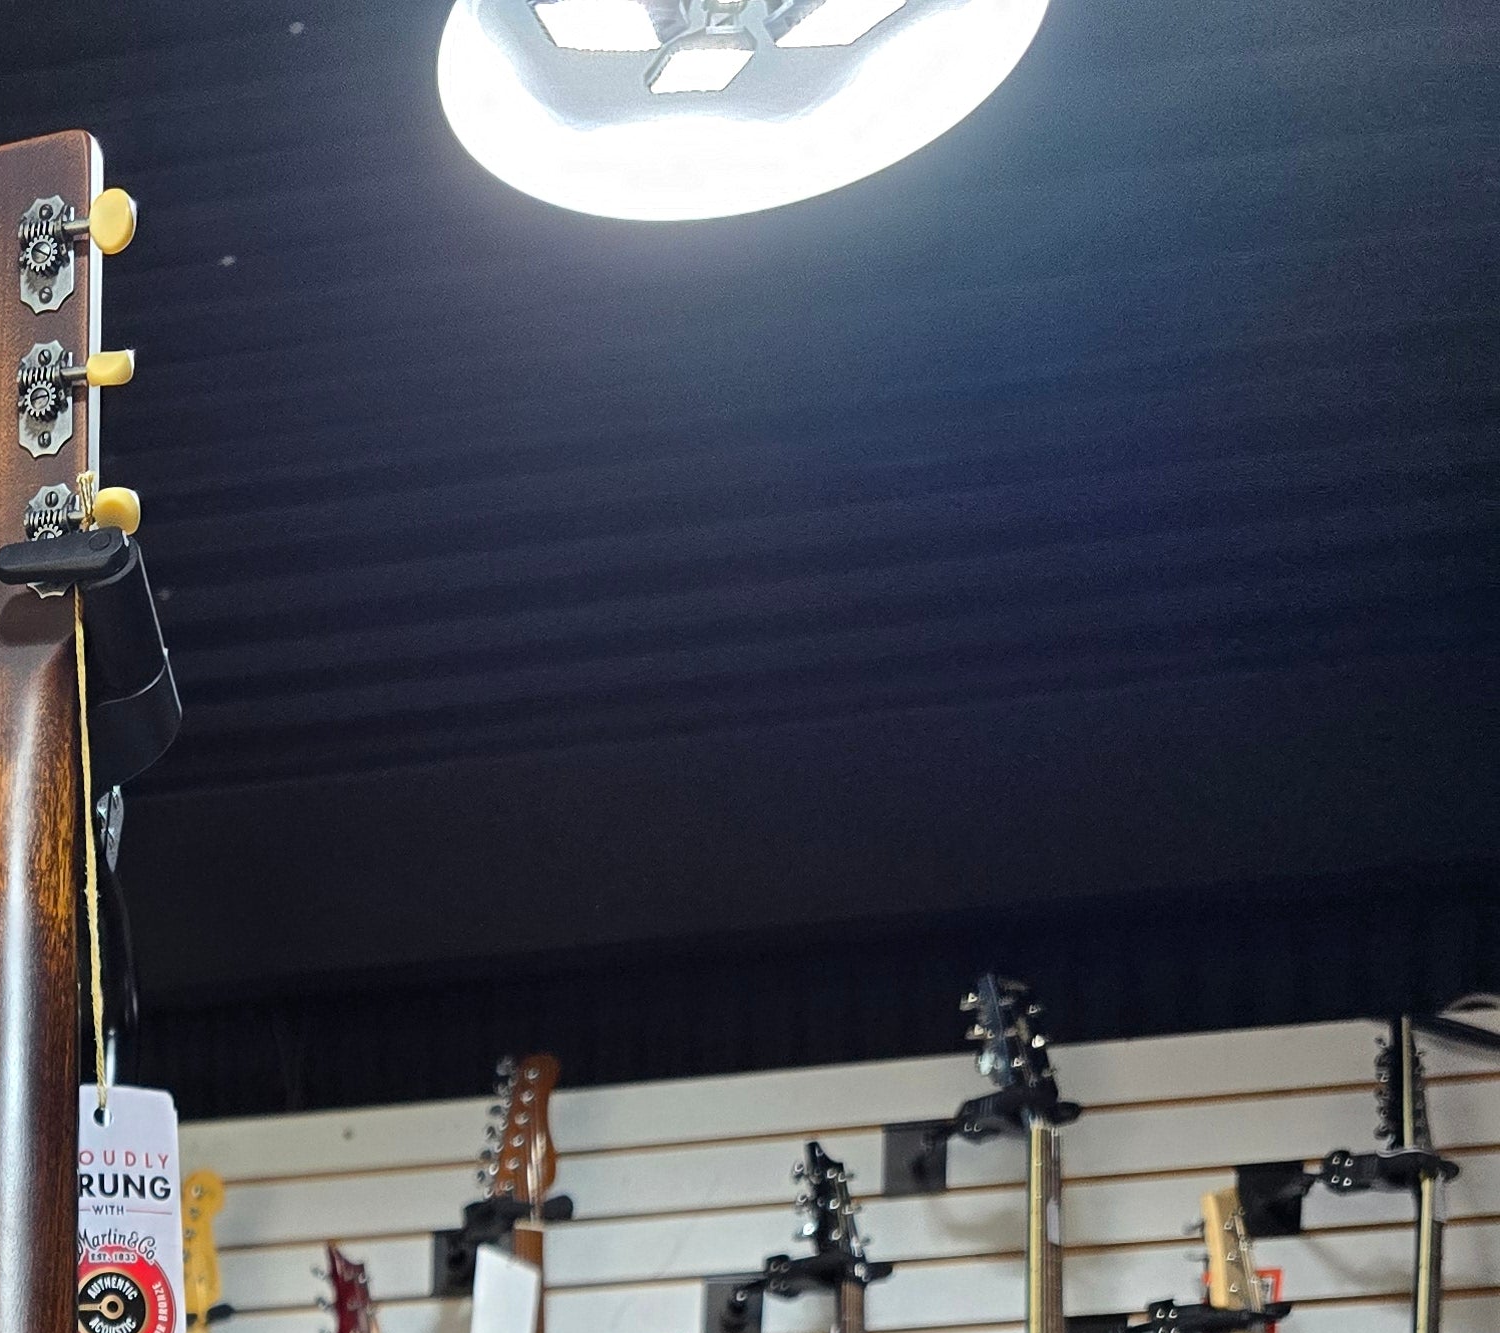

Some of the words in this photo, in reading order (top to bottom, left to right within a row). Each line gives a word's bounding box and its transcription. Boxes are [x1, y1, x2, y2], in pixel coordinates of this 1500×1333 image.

[80, 1150, 169, 1169] OUDLY
[80, 1173, 172, 1201] RUNG
[92, 1204, 125, 1216] WITH
[87, 1275, 139, 1300] AUTHENTIC
[151, 1281, 169, 1322] BRONZE
